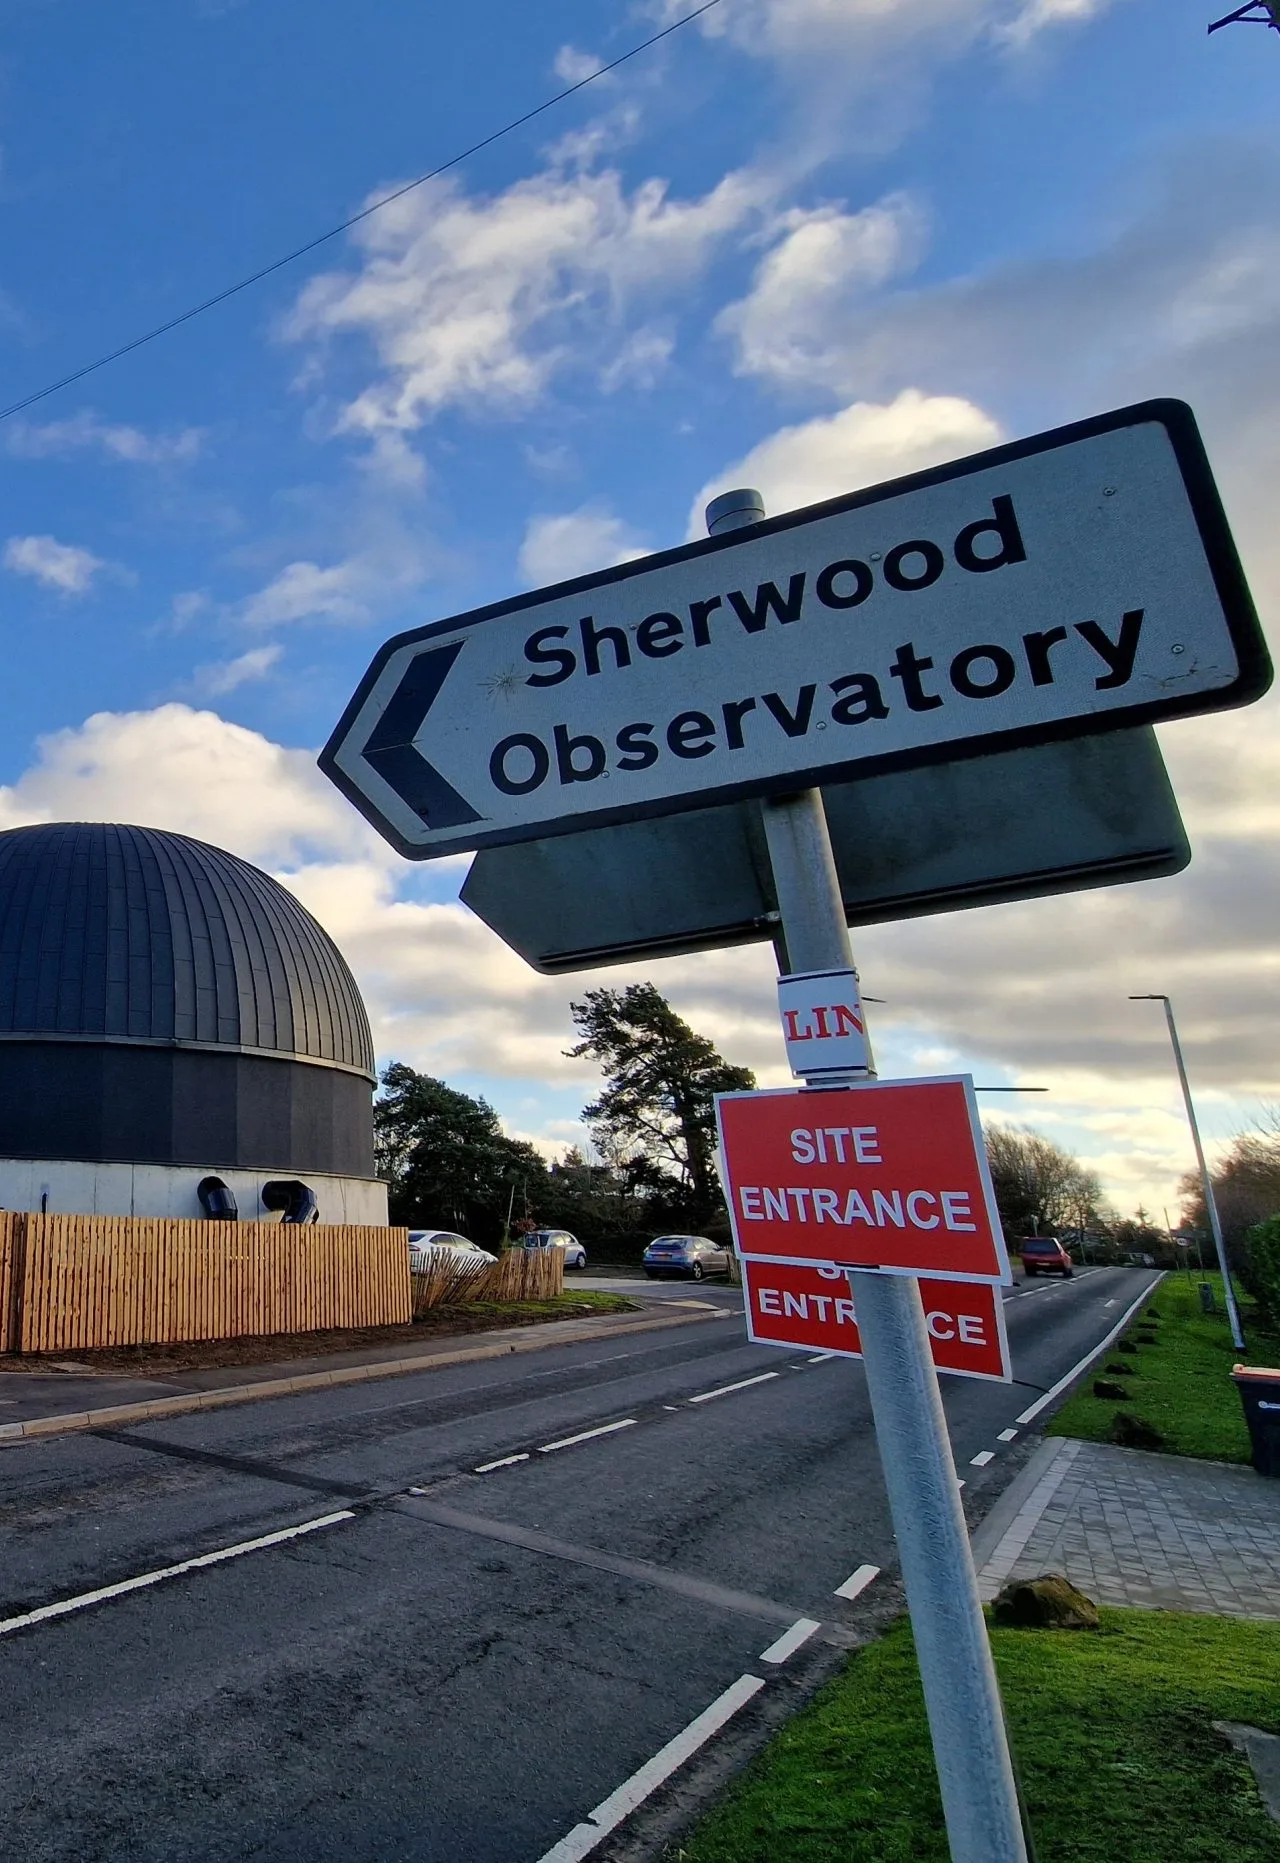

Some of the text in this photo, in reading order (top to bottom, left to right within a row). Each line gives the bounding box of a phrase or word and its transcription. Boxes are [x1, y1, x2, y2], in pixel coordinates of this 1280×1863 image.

[523, 494, 1027, 688] Sherwood
[489, 607, 1145, 797] Observatory
[789, 1126, 883, 1164] SITE
[738, 1186, 977, 1232] ENTRANCE
[758, 1288, 987, 1345] ENTRCE
